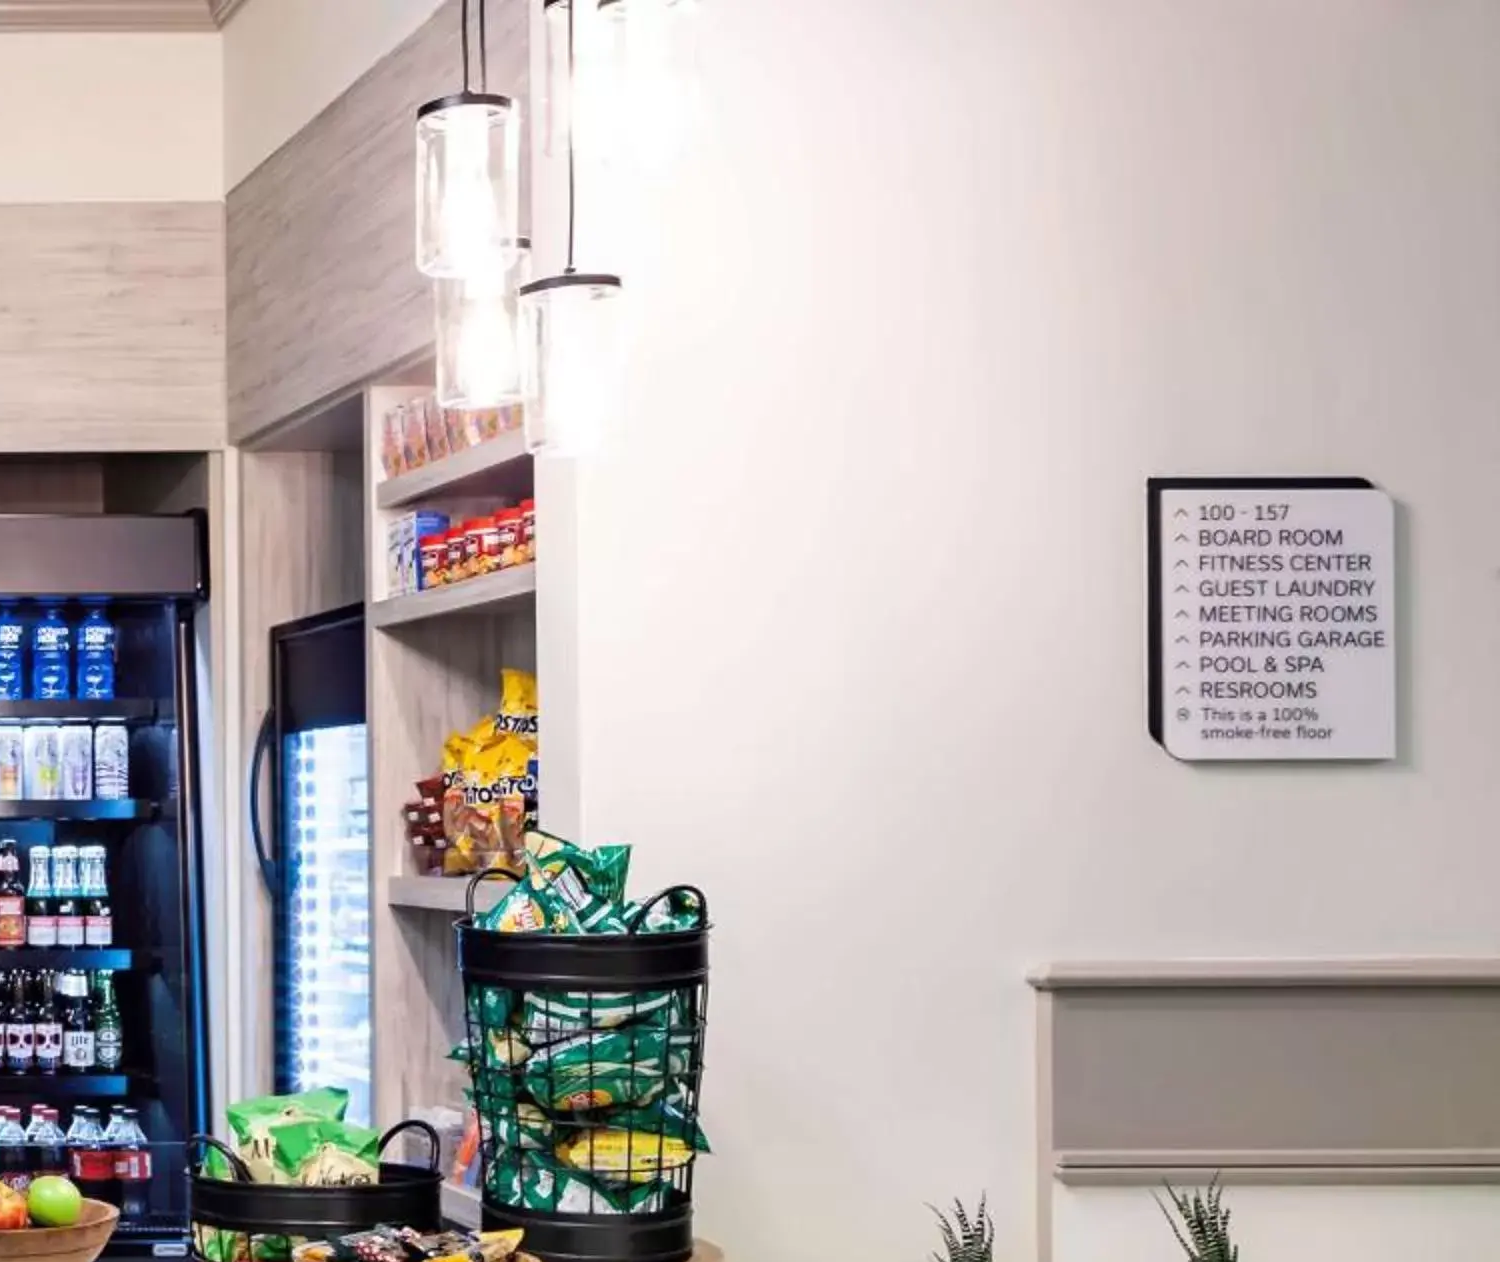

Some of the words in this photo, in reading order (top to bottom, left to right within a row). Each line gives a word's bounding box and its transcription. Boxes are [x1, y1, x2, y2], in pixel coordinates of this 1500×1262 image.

[1200, 505, 1235, 521] 100
[1255, 505, 1289, 521] 157
[1199, 530, 1272, 546] BOARD
[1279, 530, 1343, 546] ROOM
[1199, 555, 1284, 571] FITNESS
[1290, 555, 1372, 571] CENTER
[1199, 580, 1268, 597] GUEST
[1275, 580, 1375, 597] LAUNDRY
[1199, 606, 1293, 622] MEETING
[1300, 605, 1378, 622] ROOMS
[1200, 631, 1291, 648] PARKING
[1297, 631, 1385, 648] GARAGE
[1200, 656, 1258, 673] POOL
[1264, 656, 1278, 673] &
[1284, 656, 1325, 673] SPA
[1200, 682, 1318, 699] RESROOMS
[1201, 707, 1235, 722] This
[1240, 707, 1252, 722] is
[1258, 711, 1267, 722] a
[1272, 707, 1319, 722] 100%
[1201, 724, 1291, 740] smoke-free
[1296, 724, 1334, 740] floor
